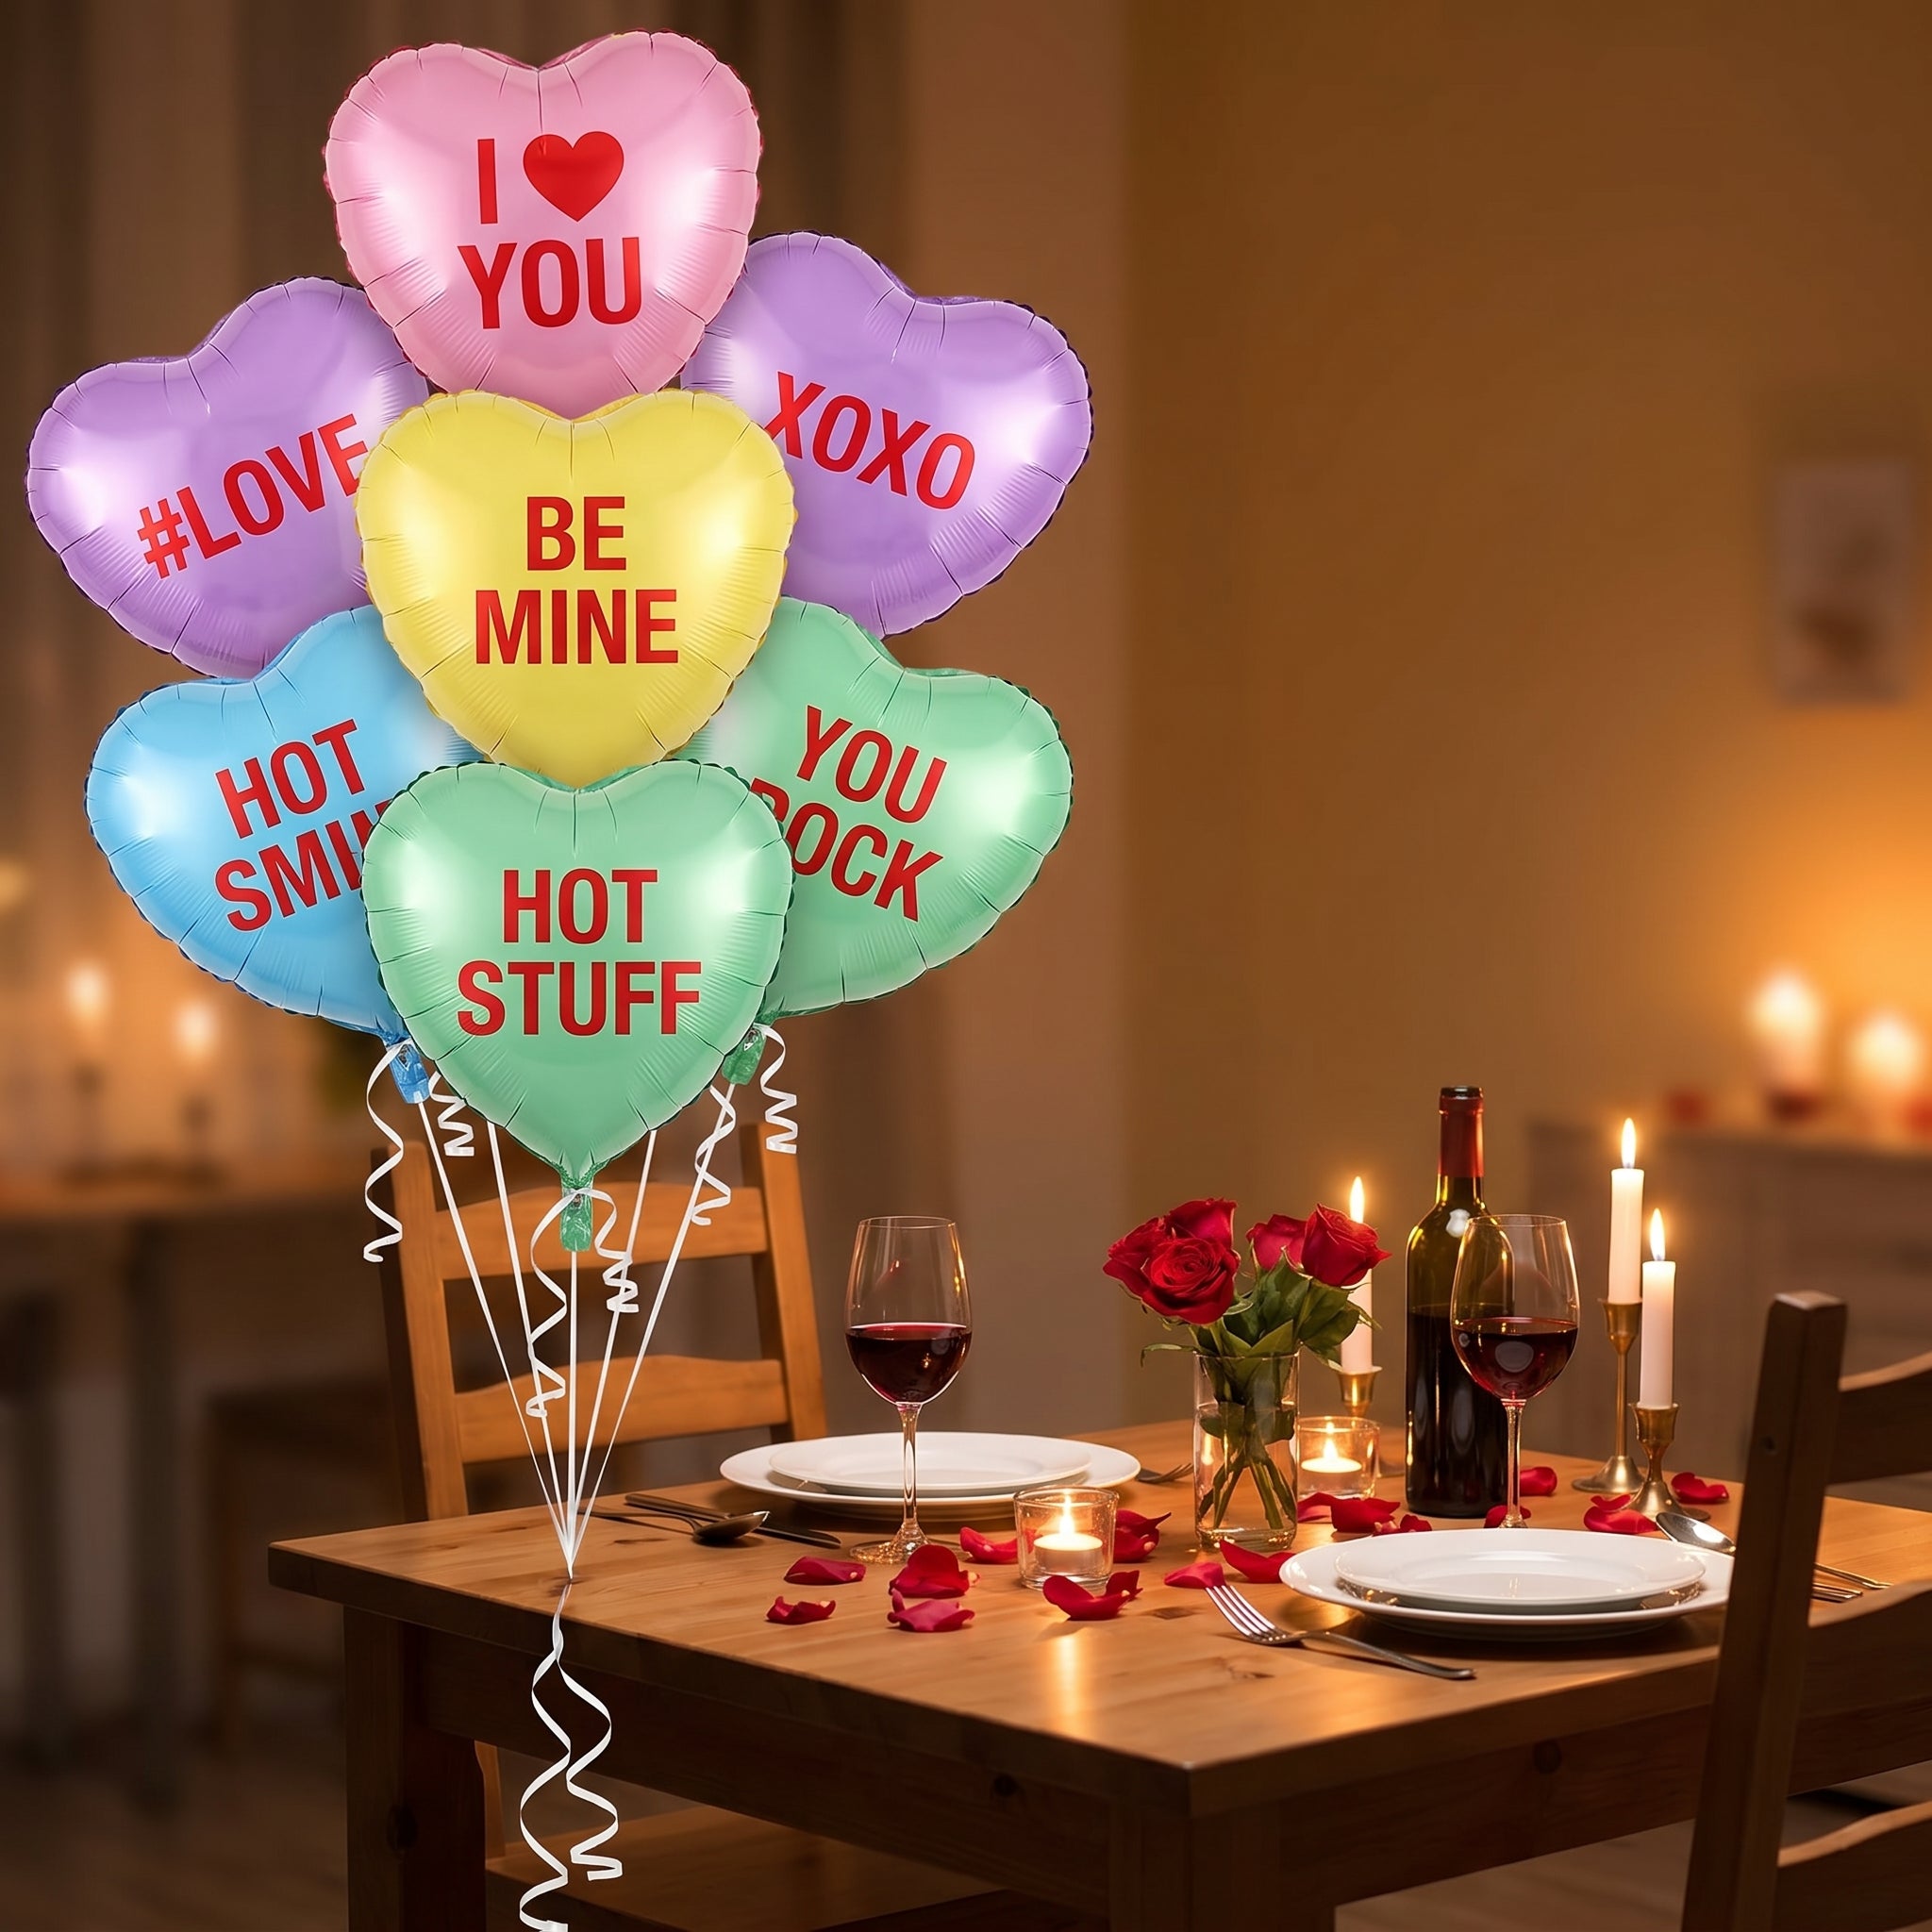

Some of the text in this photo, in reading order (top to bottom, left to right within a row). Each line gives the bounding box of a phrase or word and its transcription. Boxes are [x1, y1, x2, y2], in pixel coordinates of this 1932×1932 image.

[475, 138, 498, 225] I
[457, 237, 642, 330] YOU
[765, 371, 975, 510] XOXO
[137, 413, 369, 580] #LOVE
[525, 495, 626, 571] BE
[475, 589, 679, 664] MINE
[215, 718, 365, 840] HOT
[796, 705, 947, 824] YOU
[214, 798, 393, 931] SMI
[503, 868, 658, 943] HOT
[457, 959, 702, 1036] STUFF
